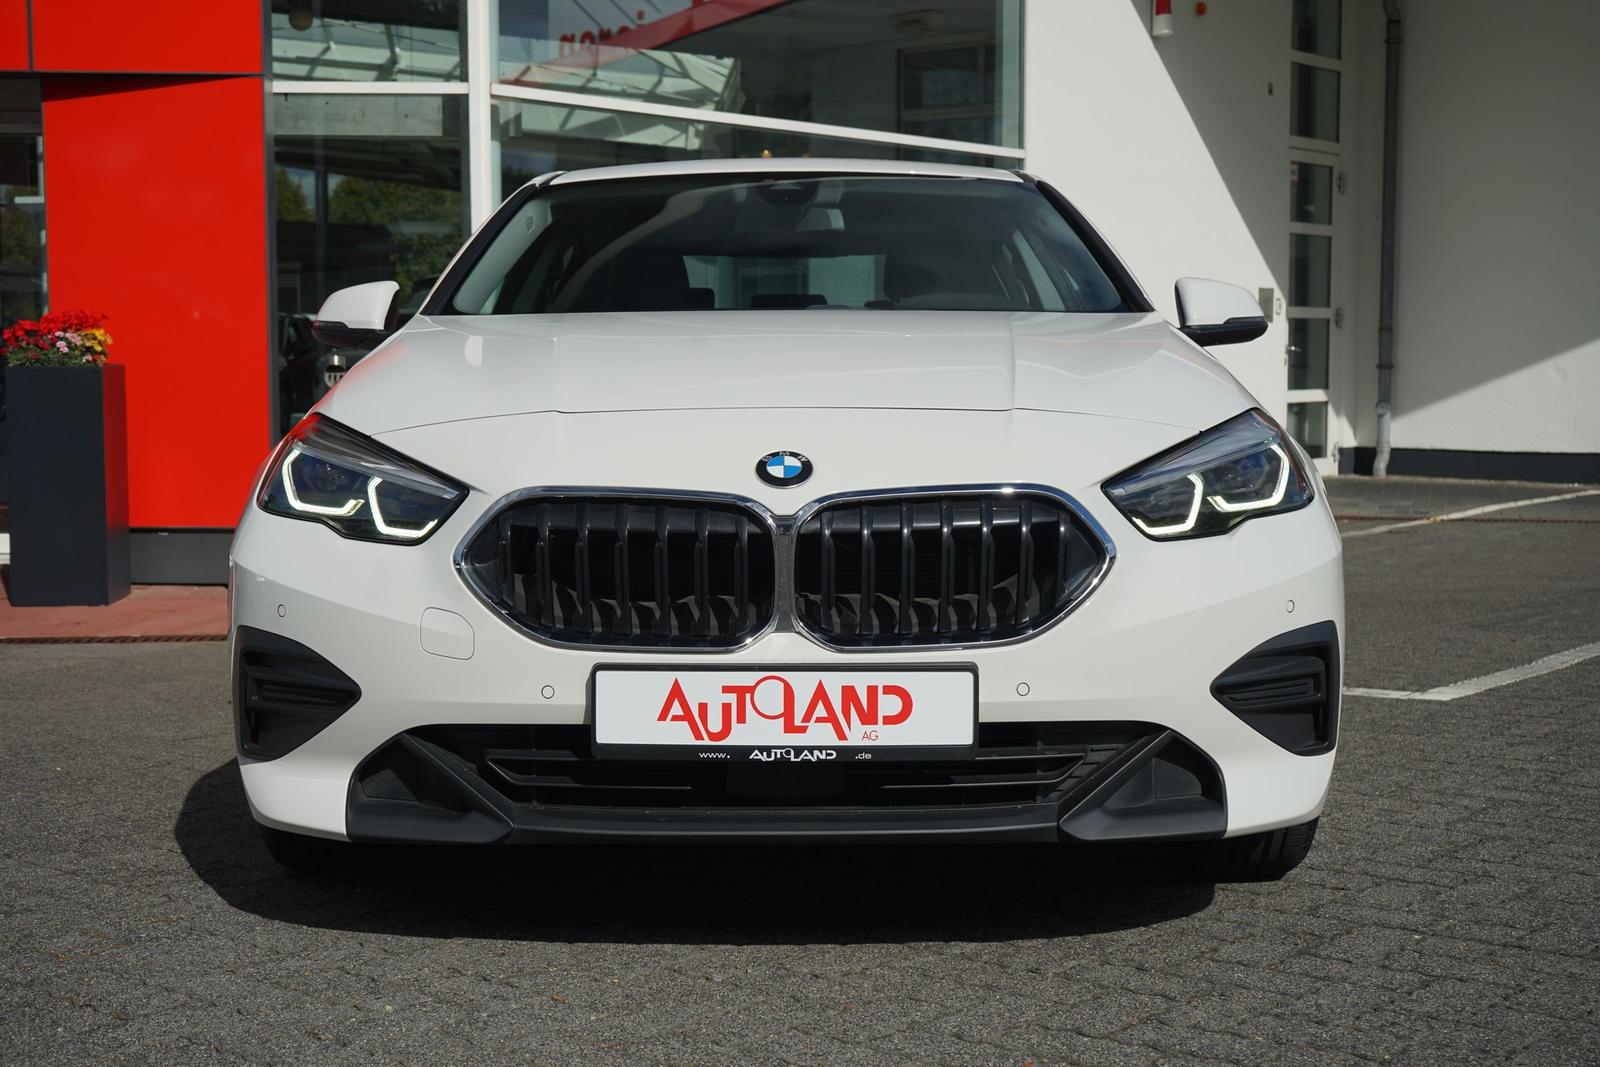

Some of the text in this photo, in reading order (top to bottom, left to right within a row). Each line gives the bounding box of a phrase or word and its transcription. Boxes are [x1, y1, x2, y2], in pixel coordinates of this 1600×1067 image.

[762, 451, 809, 462] BMW
[657, 675, 914, 742] AUTOLAND
[861, 730, 879, 742] AG
[749, 748, 836, 762] AUTOLAND
[855, 751, 872, 760] .de
